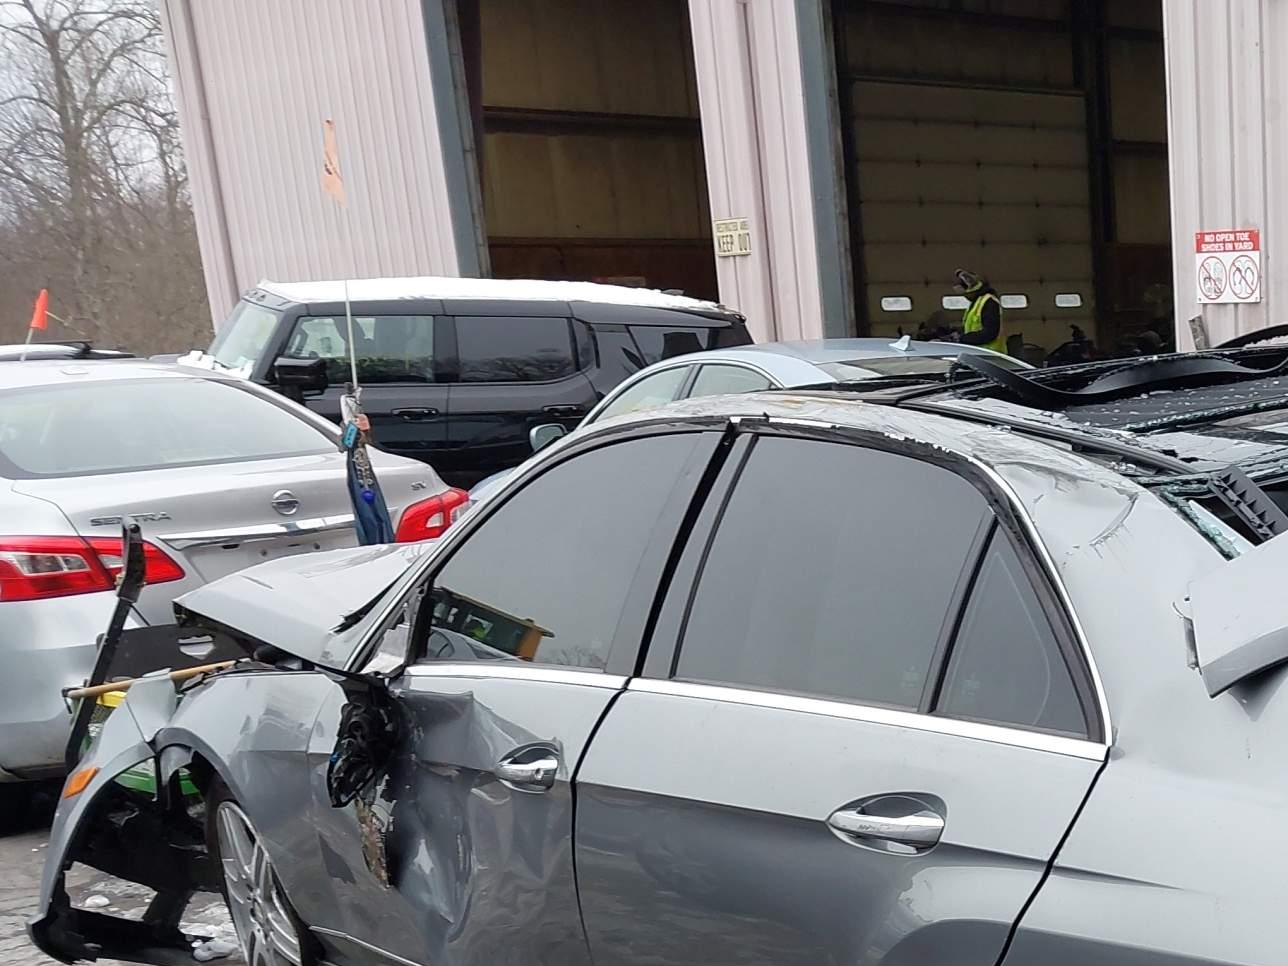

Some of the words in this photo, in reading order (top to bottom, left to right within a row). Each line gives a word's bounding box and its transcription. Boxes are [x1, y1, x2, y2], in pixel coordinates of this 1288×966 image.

[1204, 233, 1215, 242] NO
[1216, 232, 1235, 242] OPEN
[1235, 232, 1250, 241] TOE
[1201, 243, 1224, 252] SHOES
[1225, 242, 1234, 251] IN
[1234, 241, 1254, 251] YARD
